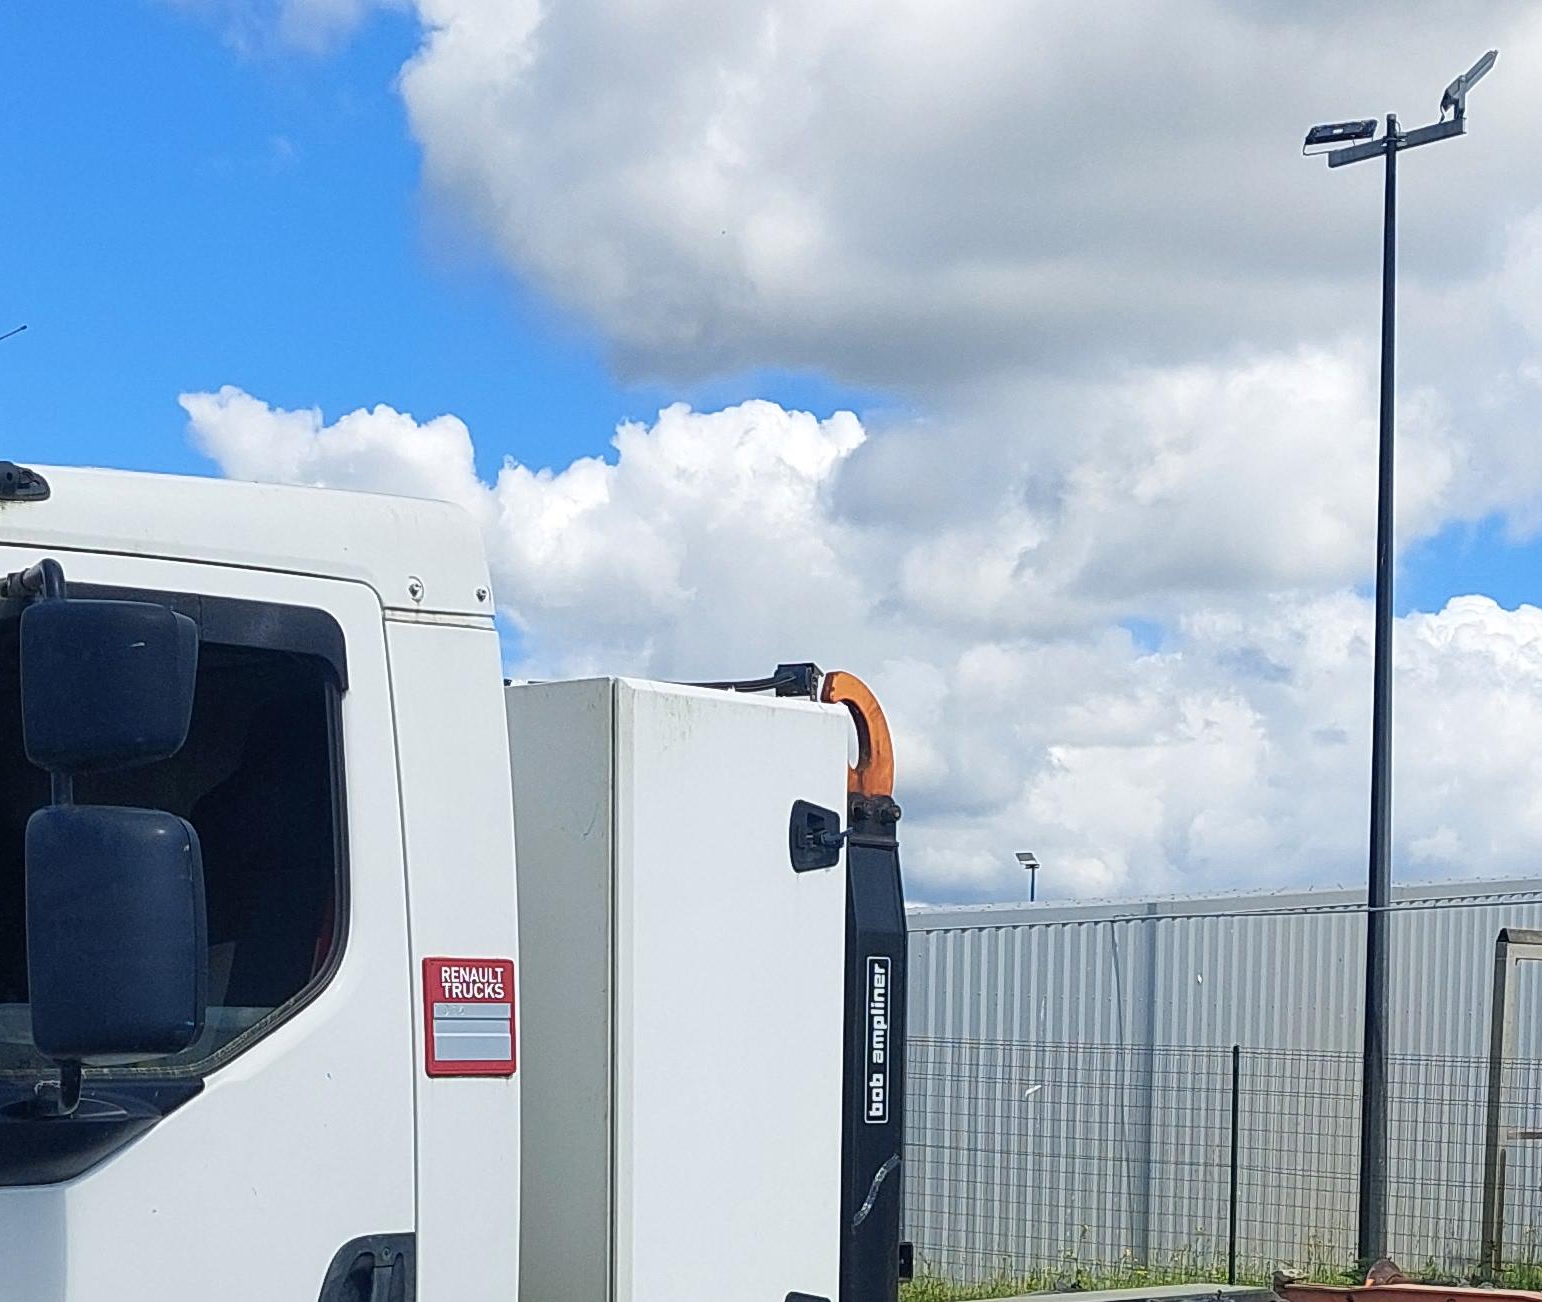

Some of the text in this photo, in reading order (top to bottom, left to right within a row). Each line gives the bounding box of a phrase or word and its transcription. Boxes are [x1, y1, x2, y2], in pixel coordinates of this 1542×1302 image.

[441, 966, 504, 983] RENAULT
[441, 982, 505, 999] TRUCKS
[869, 962, 888, 1117] bob ampliner
